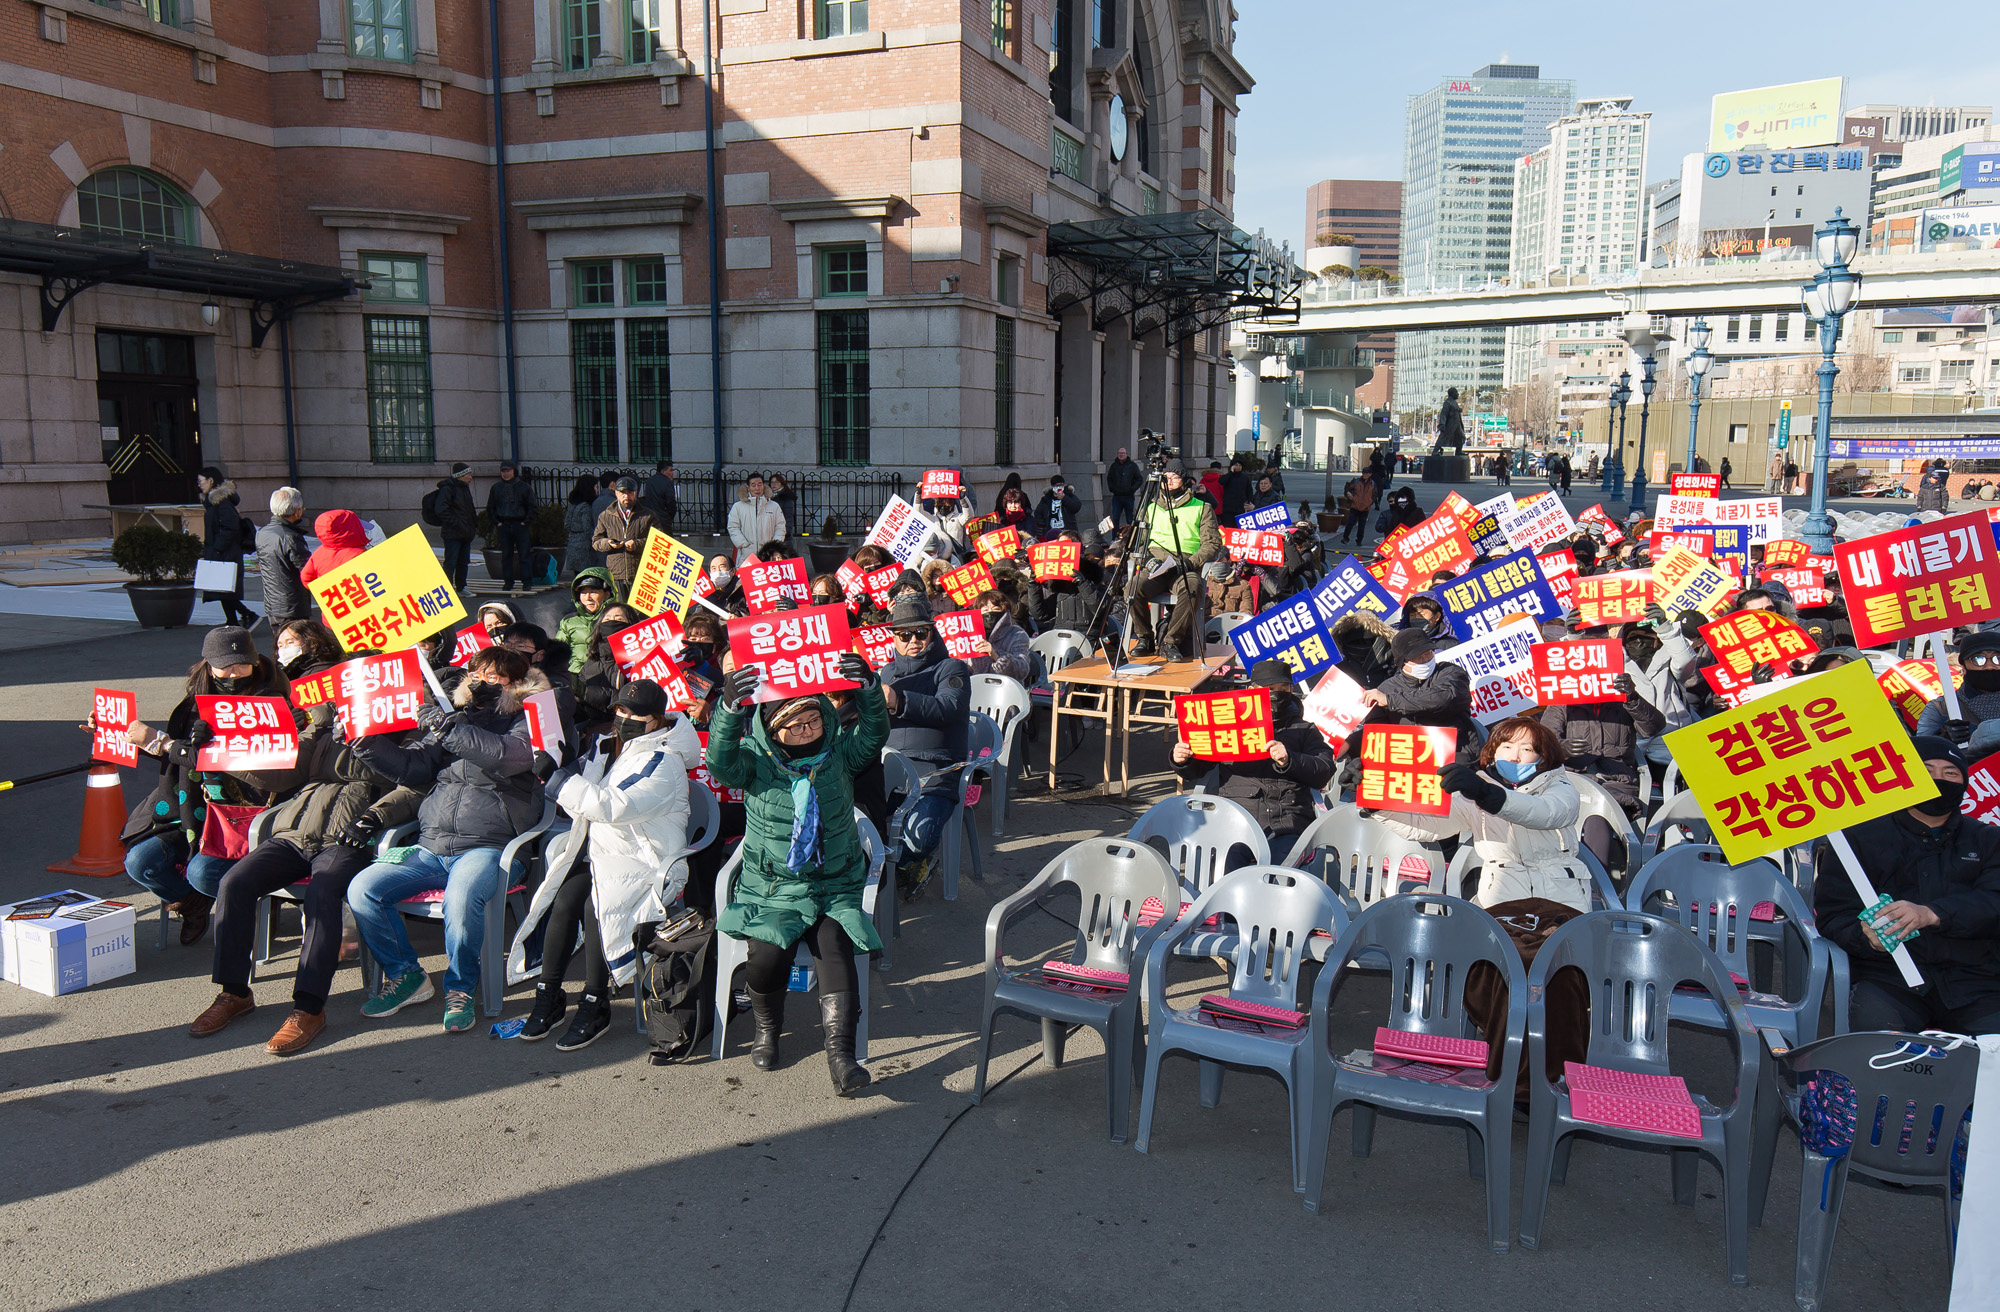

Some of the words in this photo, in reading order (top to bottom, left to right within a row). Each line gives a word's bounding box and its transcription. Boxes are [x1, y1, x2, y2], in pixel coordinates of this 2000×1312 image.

[1450, 81, 1471, 92] AIA
[1850, 125, 1876, 138] 에스원
[1737, 150, 1863, 175] 한진택배
[923, 484, 958, 496] 구속하라
[927, 471, 954, 483] 윤성재
[1675, 476, 1717, 489] 상면회사는
[885, 502, 912, 532] 외면하는
[1255, 505, 1288, 526] 이더리움
[1505, 522, 1515, 533] 왜
[1513, 505, 1542, 528] 피해자를
[1540, 496, 1557, 512] 잡고
[1670, 499, 1705, 515] 윤성재를
[1716, 504, 1750, 520] 채굴기
[1756, 502, 1778, 518] 도둑
[901, 517, 928, 546] 각성하라
[1398, 515, 1457, 559] 상면회사는
[1467, 517, 1498, 542] 점유한
[1511, 524, 1539, 545] 가해자는
[1537, 508, 1565, 530] 풀어주는
[1657, 516, 1675, 531] 즉각
[649, 534, 674, 566] 살겠다
[872, 526, 895, 550] 해자를
[976, 529, 1014, 554] 채굴기
[1231, 531, 1257, 546] 윤성재
[1660, 535, 1703, 554] 윤성재
[1715, 529, 1738, 548] 붙잡지
[1767, 540, 1807, 555] 채굴기
[893, 543, 912, 566] 찰은
[982, 543, 1018, 565] 돌려줘
[1034, 545, 1076, 560] 채굴기
[1226, 545, 1260, 561] 구속하라
[1412, 537, 1462, 574] 책임져라
[1848, 549, 1882, 588] 내
[1888, 525, 1984, 578] 채굴기
[646, 561, 665, 578] 못
[670, 550, 696, 589] 돌려줘
[751, 563, 797, 587] 윤성재
[867, 567, 899, 590] 윤성재
[943, 562, 986, 591] 채굴기
[1035, 562, 1075, 578] 돌려줘
[1660, 551, 1699, 587] 소리에
[1771, 570, 1813, 587] 윤성재
[320, 572, 386, 620] 검찰은
[635, 572, 662, 612] 힘들어서
[749, 583, 809, 609] 구속하라
[952, 577, 992, 606] 돌려줘
[1443, 576, 1487, 613] 채굴기
[1481, 556, 1537, 599] 불법점유
[1577, 578, 1646, 600] 채굴기
[1465, 589, 1545, 638] 처벌하라
[1579, 596, 1647, 622] 돌려줘
[1864, 572, 1992, 634] 돌려줘
[342, 585, 454, 652] 공정수사해라
[935, 614, 974, 637] 윤성재
[1237, 630, 1261, 658] 내
[1256, 601, 1316, 649] 이더리움
[1709, 612, 1790, 648] 채굴기
[622, 618, 673, 656] 윤성재
[750, 613, 832, 655] 윤성재
[944, 634, 984, 657] 속하라
[1275, 633, 1330, 674] 려줘
[1466, 643, 1506, 676] 마음대로
[1547, 645, 1608, 670] 윤성재
[1725, 629, 1807, 674] 돌려줘
[340, 659, 405, 698] 윤성재
[1541, 672, 1621, 699] 구속하라
[95, 694, 129, 726] 윤성재
[1184, 695, 1263, 726] 채굴기
[1470, 680, 1509, 718] 지검은
[215, 701, 280, 729] 윤성재
[338, 692, 420, 735] 구속하라
[208, 733, 295, 765] 구속하라
[1188, 727, 1268, 756] 돌려줘
[1363, 731, 1443, 768] 채굴기
[1706, 697, 1853, 776] 검찰은
[1361, 769, 1443, 807] 돌려줘
[1714, 740, 1915, 839] 각성하라
[91, 934, 131, 958] miilk
[792, 966, 800, 982] REE
[1903, 1062, 1934, 1076] SOK
